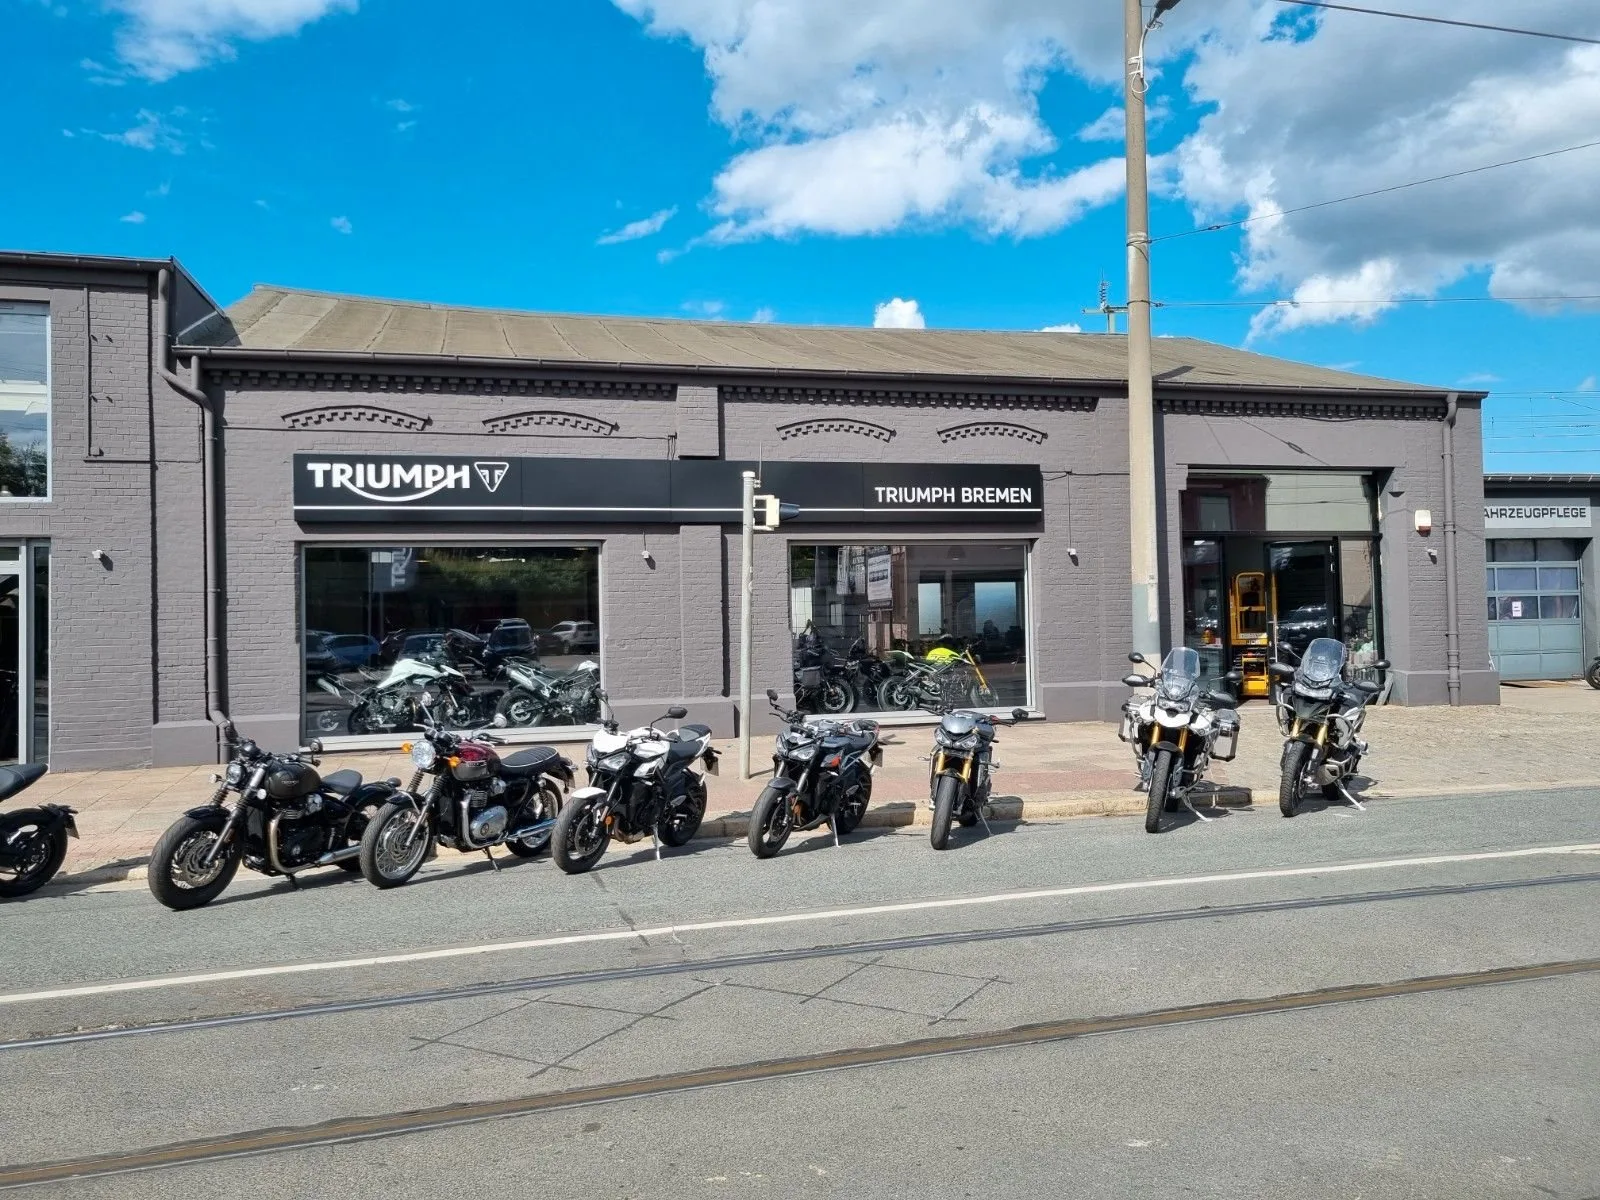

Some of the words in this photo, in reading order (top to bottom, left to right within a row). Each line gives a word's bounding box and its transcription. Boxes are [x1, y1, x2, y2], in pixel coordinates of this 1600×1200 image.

[306, 462, 471, 502] TRIUMPH
[874, 486, 956, 504] TRIUMPH
[961, 487, 1032, 503] BREMEN
[1484, 507, 1587, 519] AHRZEUGPFLEGE
